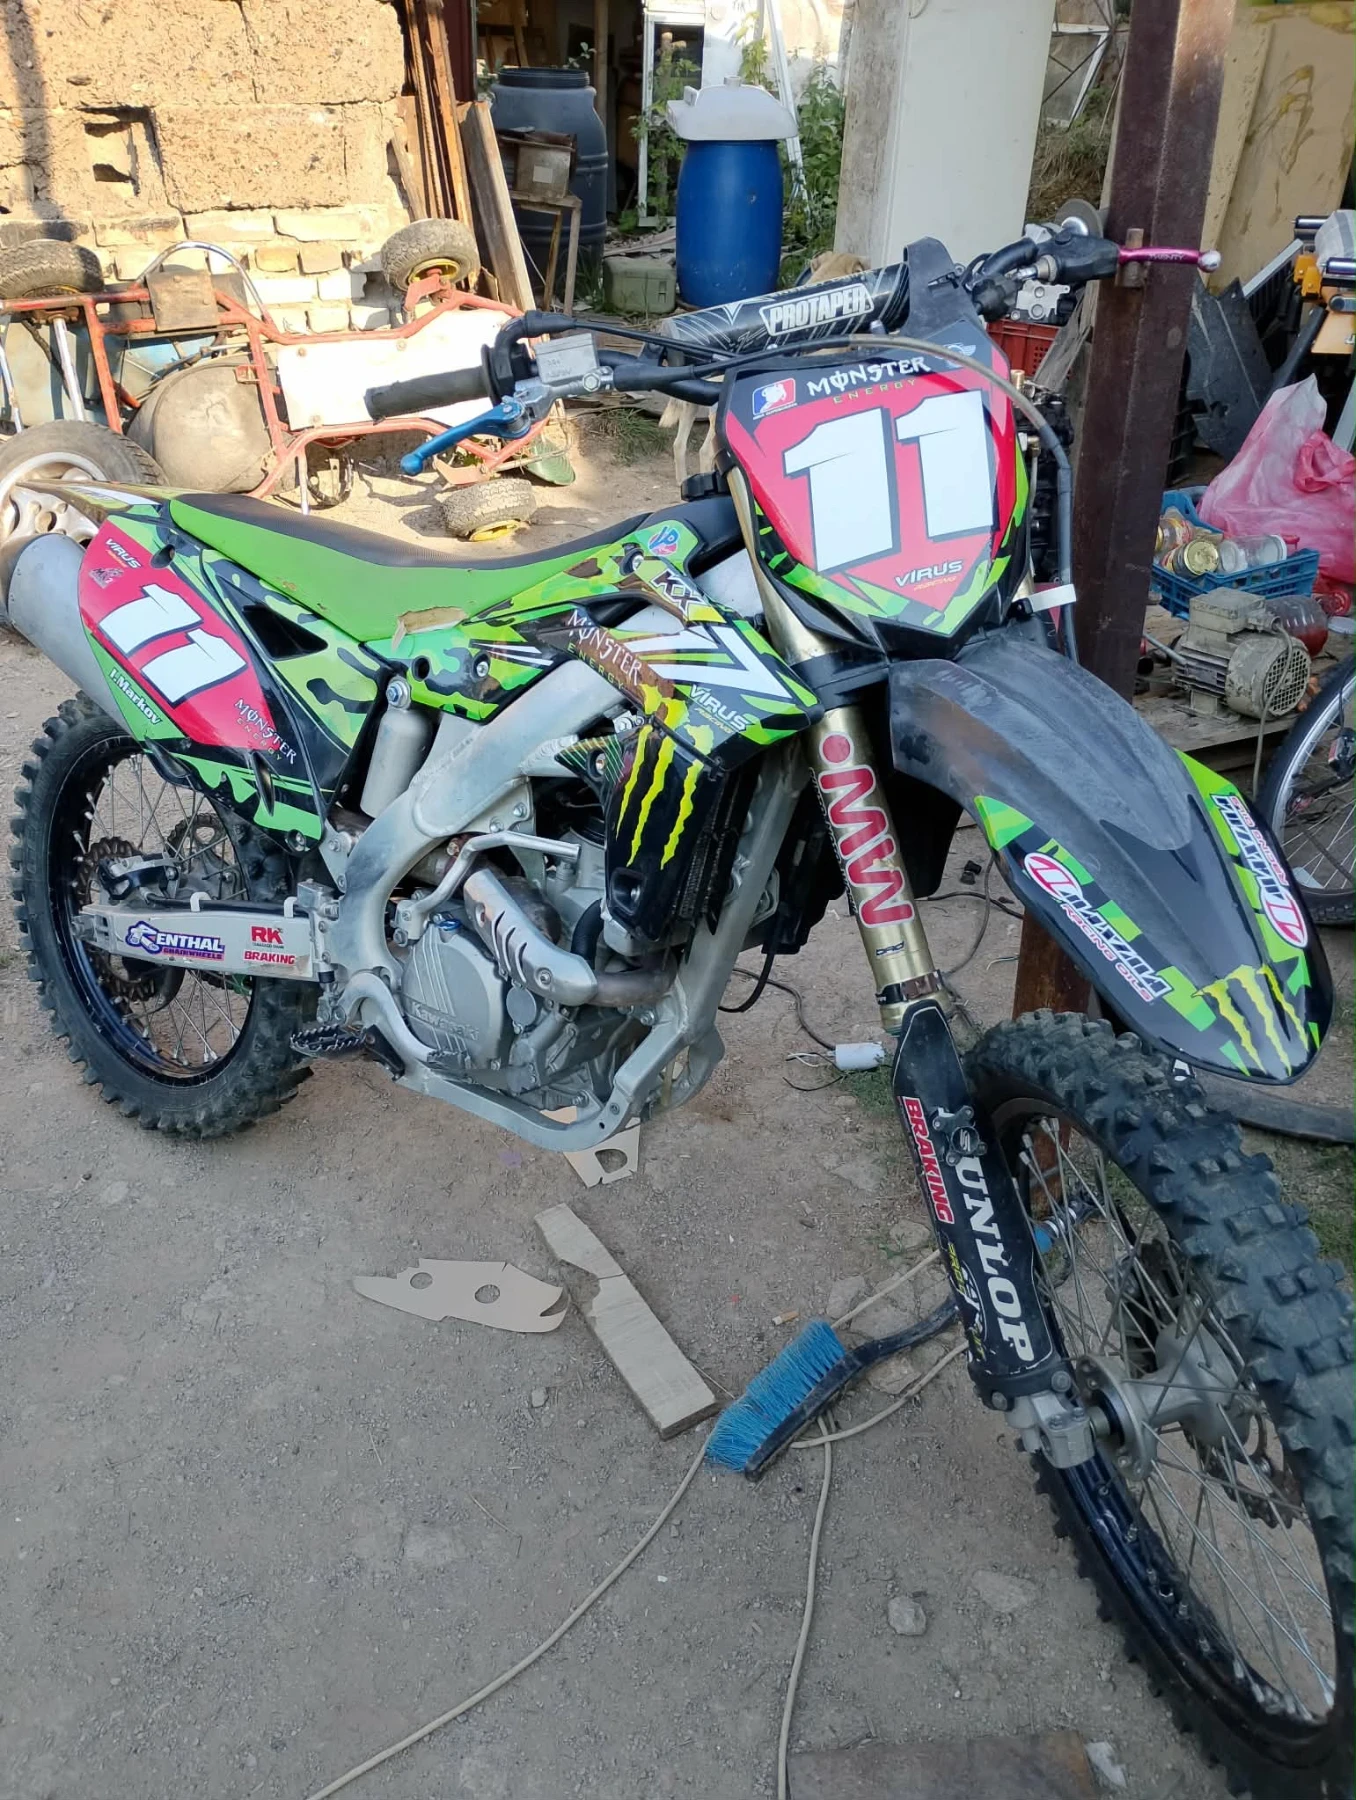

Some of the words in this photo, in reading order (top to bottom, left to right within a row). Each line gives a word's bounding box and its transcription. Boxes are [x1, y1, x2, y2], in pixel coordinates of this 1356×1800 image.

[768, 287, 867, 333] PROTAPER
[806, 357, 932, 396] MONSTER
[833, 379, 917, 404] ENERGY
[783, 389, 994, 573] 11
[105, 538, 142, 568] VIRUS
[894, 559, 963, 587] VIRUS
[99, 583, 248, 704] 11
[567, 609, 642, 686] MONSTER
[567, 642, 625, 690] ENERGY
[234, 698, 297, 765] MONSTER
[689, 684, 751, 732] VIRUS
[237, 717, 282, 761] ENERGY
[1230, 796, 1256, 828] OILS
[1252, 829, 1290, 886] RACING
[244, 950, 296, 965] BRAKING
[251, 926, 284, 944] RK
[1060, 903, 1117, 961] RACING
[1115, 962, 1154, 1002] OILS
[902, 1096, 955, 1224] BRAKING
[938, 1107, 1034, 1362] UNLOP
